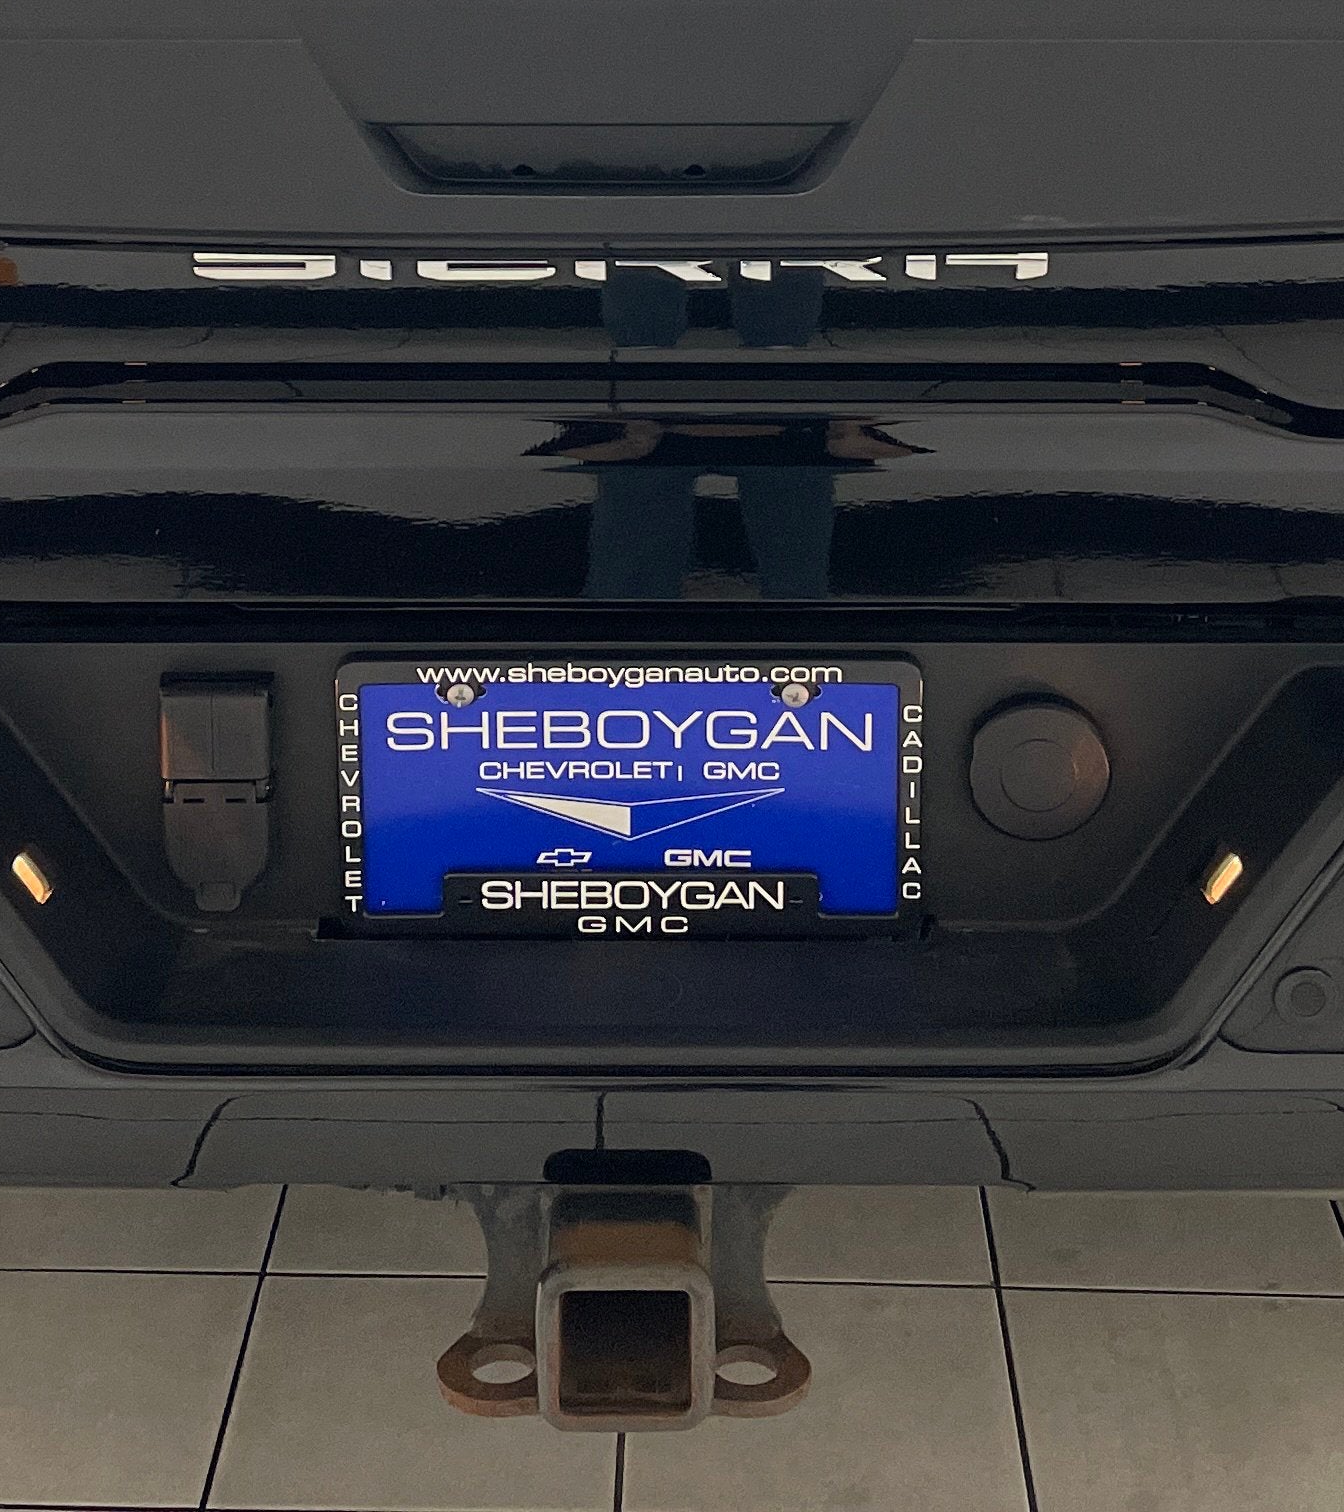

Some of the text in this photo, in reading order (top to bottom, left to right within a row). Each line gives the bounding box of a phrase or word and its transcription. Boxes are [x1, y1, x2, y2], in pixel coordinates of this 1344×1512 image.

[417, 663, 843, 687] www.sheboyganauto.com
[386, 711, 873, 752] SHEBOYGAN
[479, 761, 780, 781] CHEVROLET GMC
[338, 695, 362, 913] CHEVROLET
[901, 705, 923, 900] CADILLAC
[663, 849, 752, 868] GMC
[481, 882, 785, 911] SHEBOYGAN
[578, 916, 690, 934] GMC
